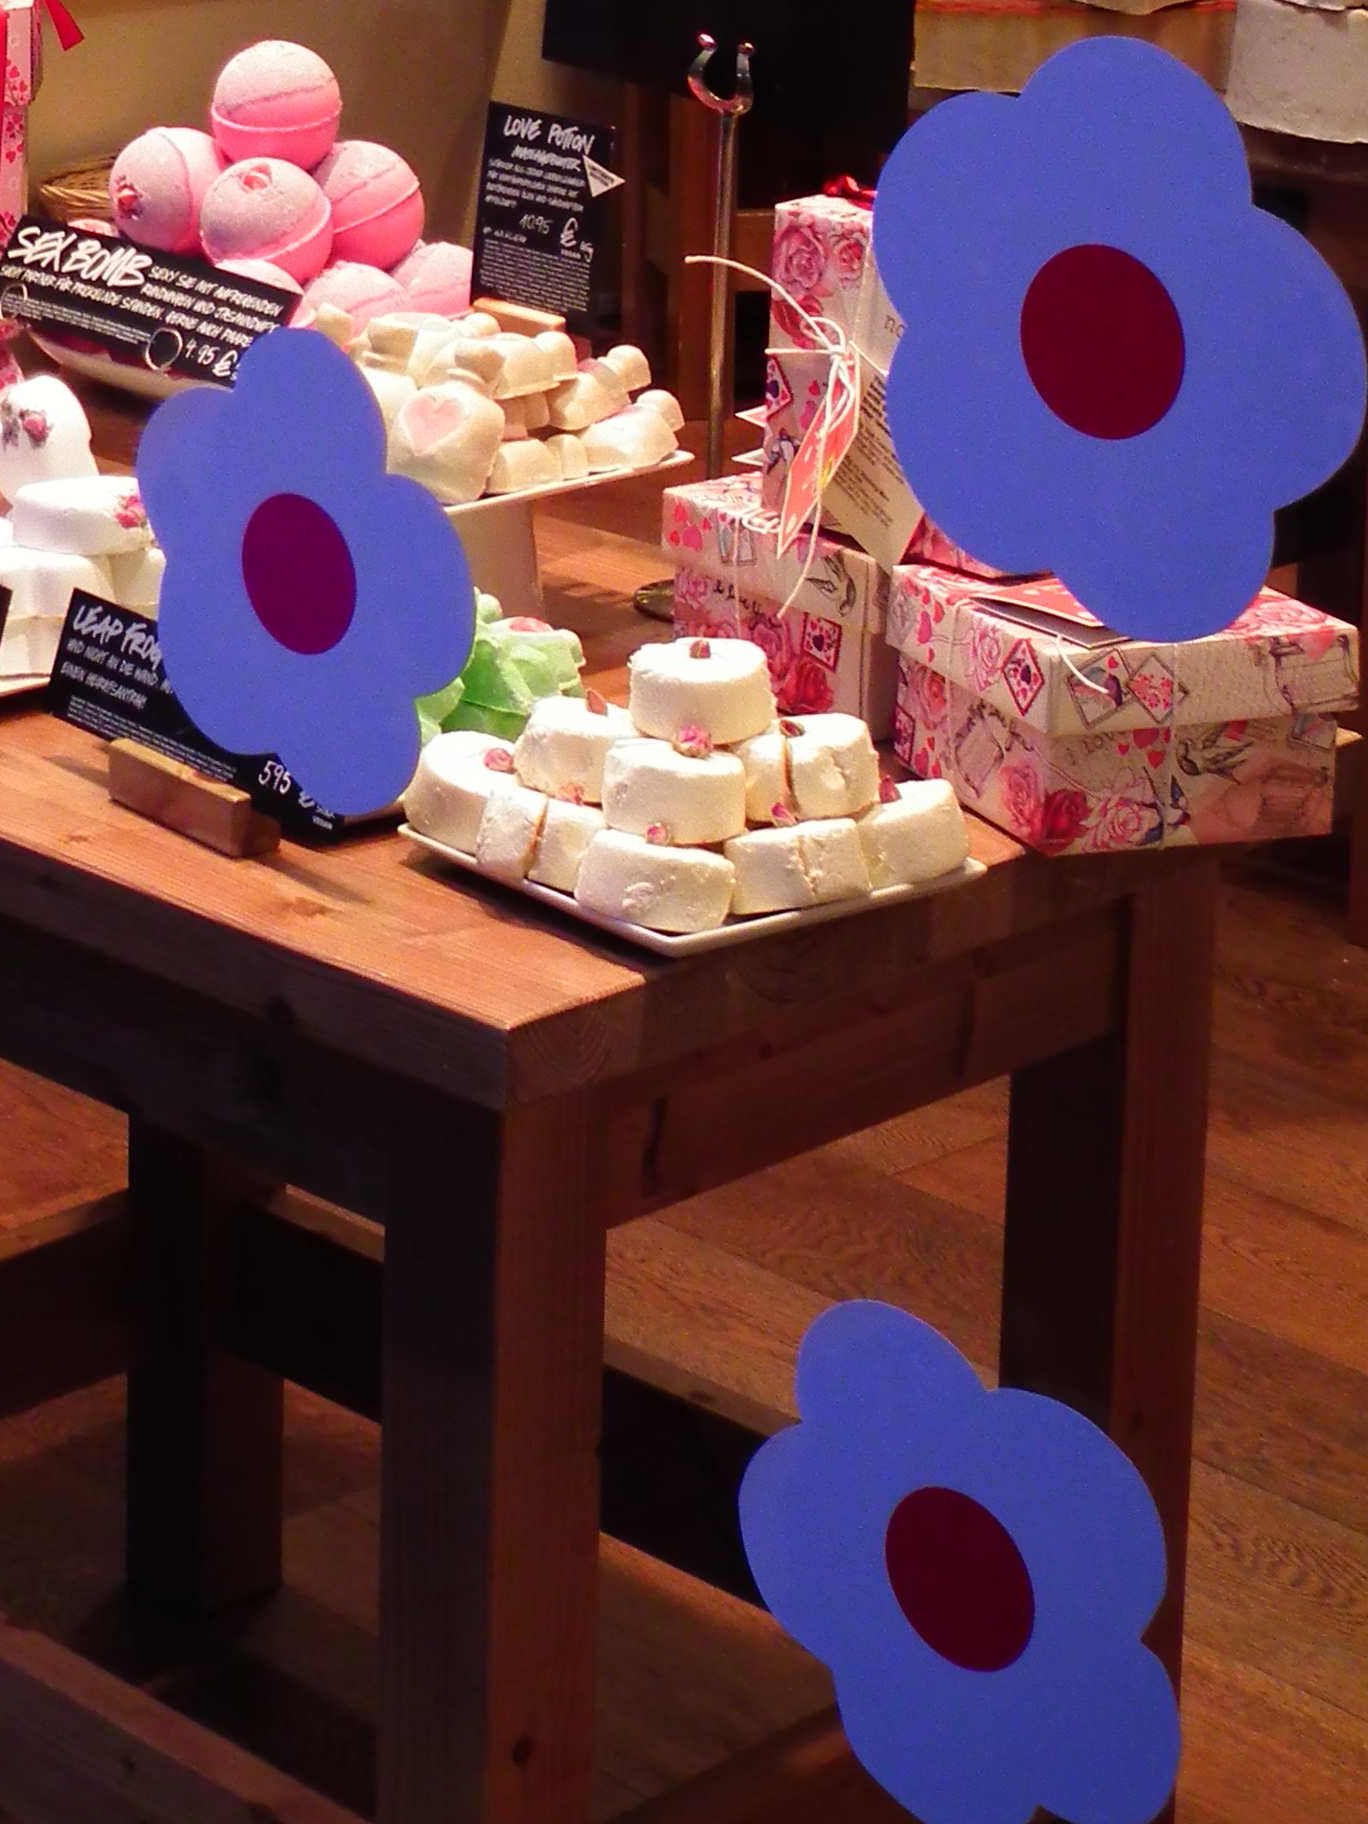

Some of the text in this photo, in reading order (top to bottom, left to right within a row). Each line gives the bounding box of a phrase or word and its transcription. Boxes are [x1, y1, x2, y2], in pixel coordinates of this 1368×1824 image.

[503, 115, 596, 156] LOVE POTION
[148, 266, 180, 283] SEXY
[176, 274, 197, 289] SIE
[193, 299, 215, 315] UND
[73, 605, 123, 645] LEAP
